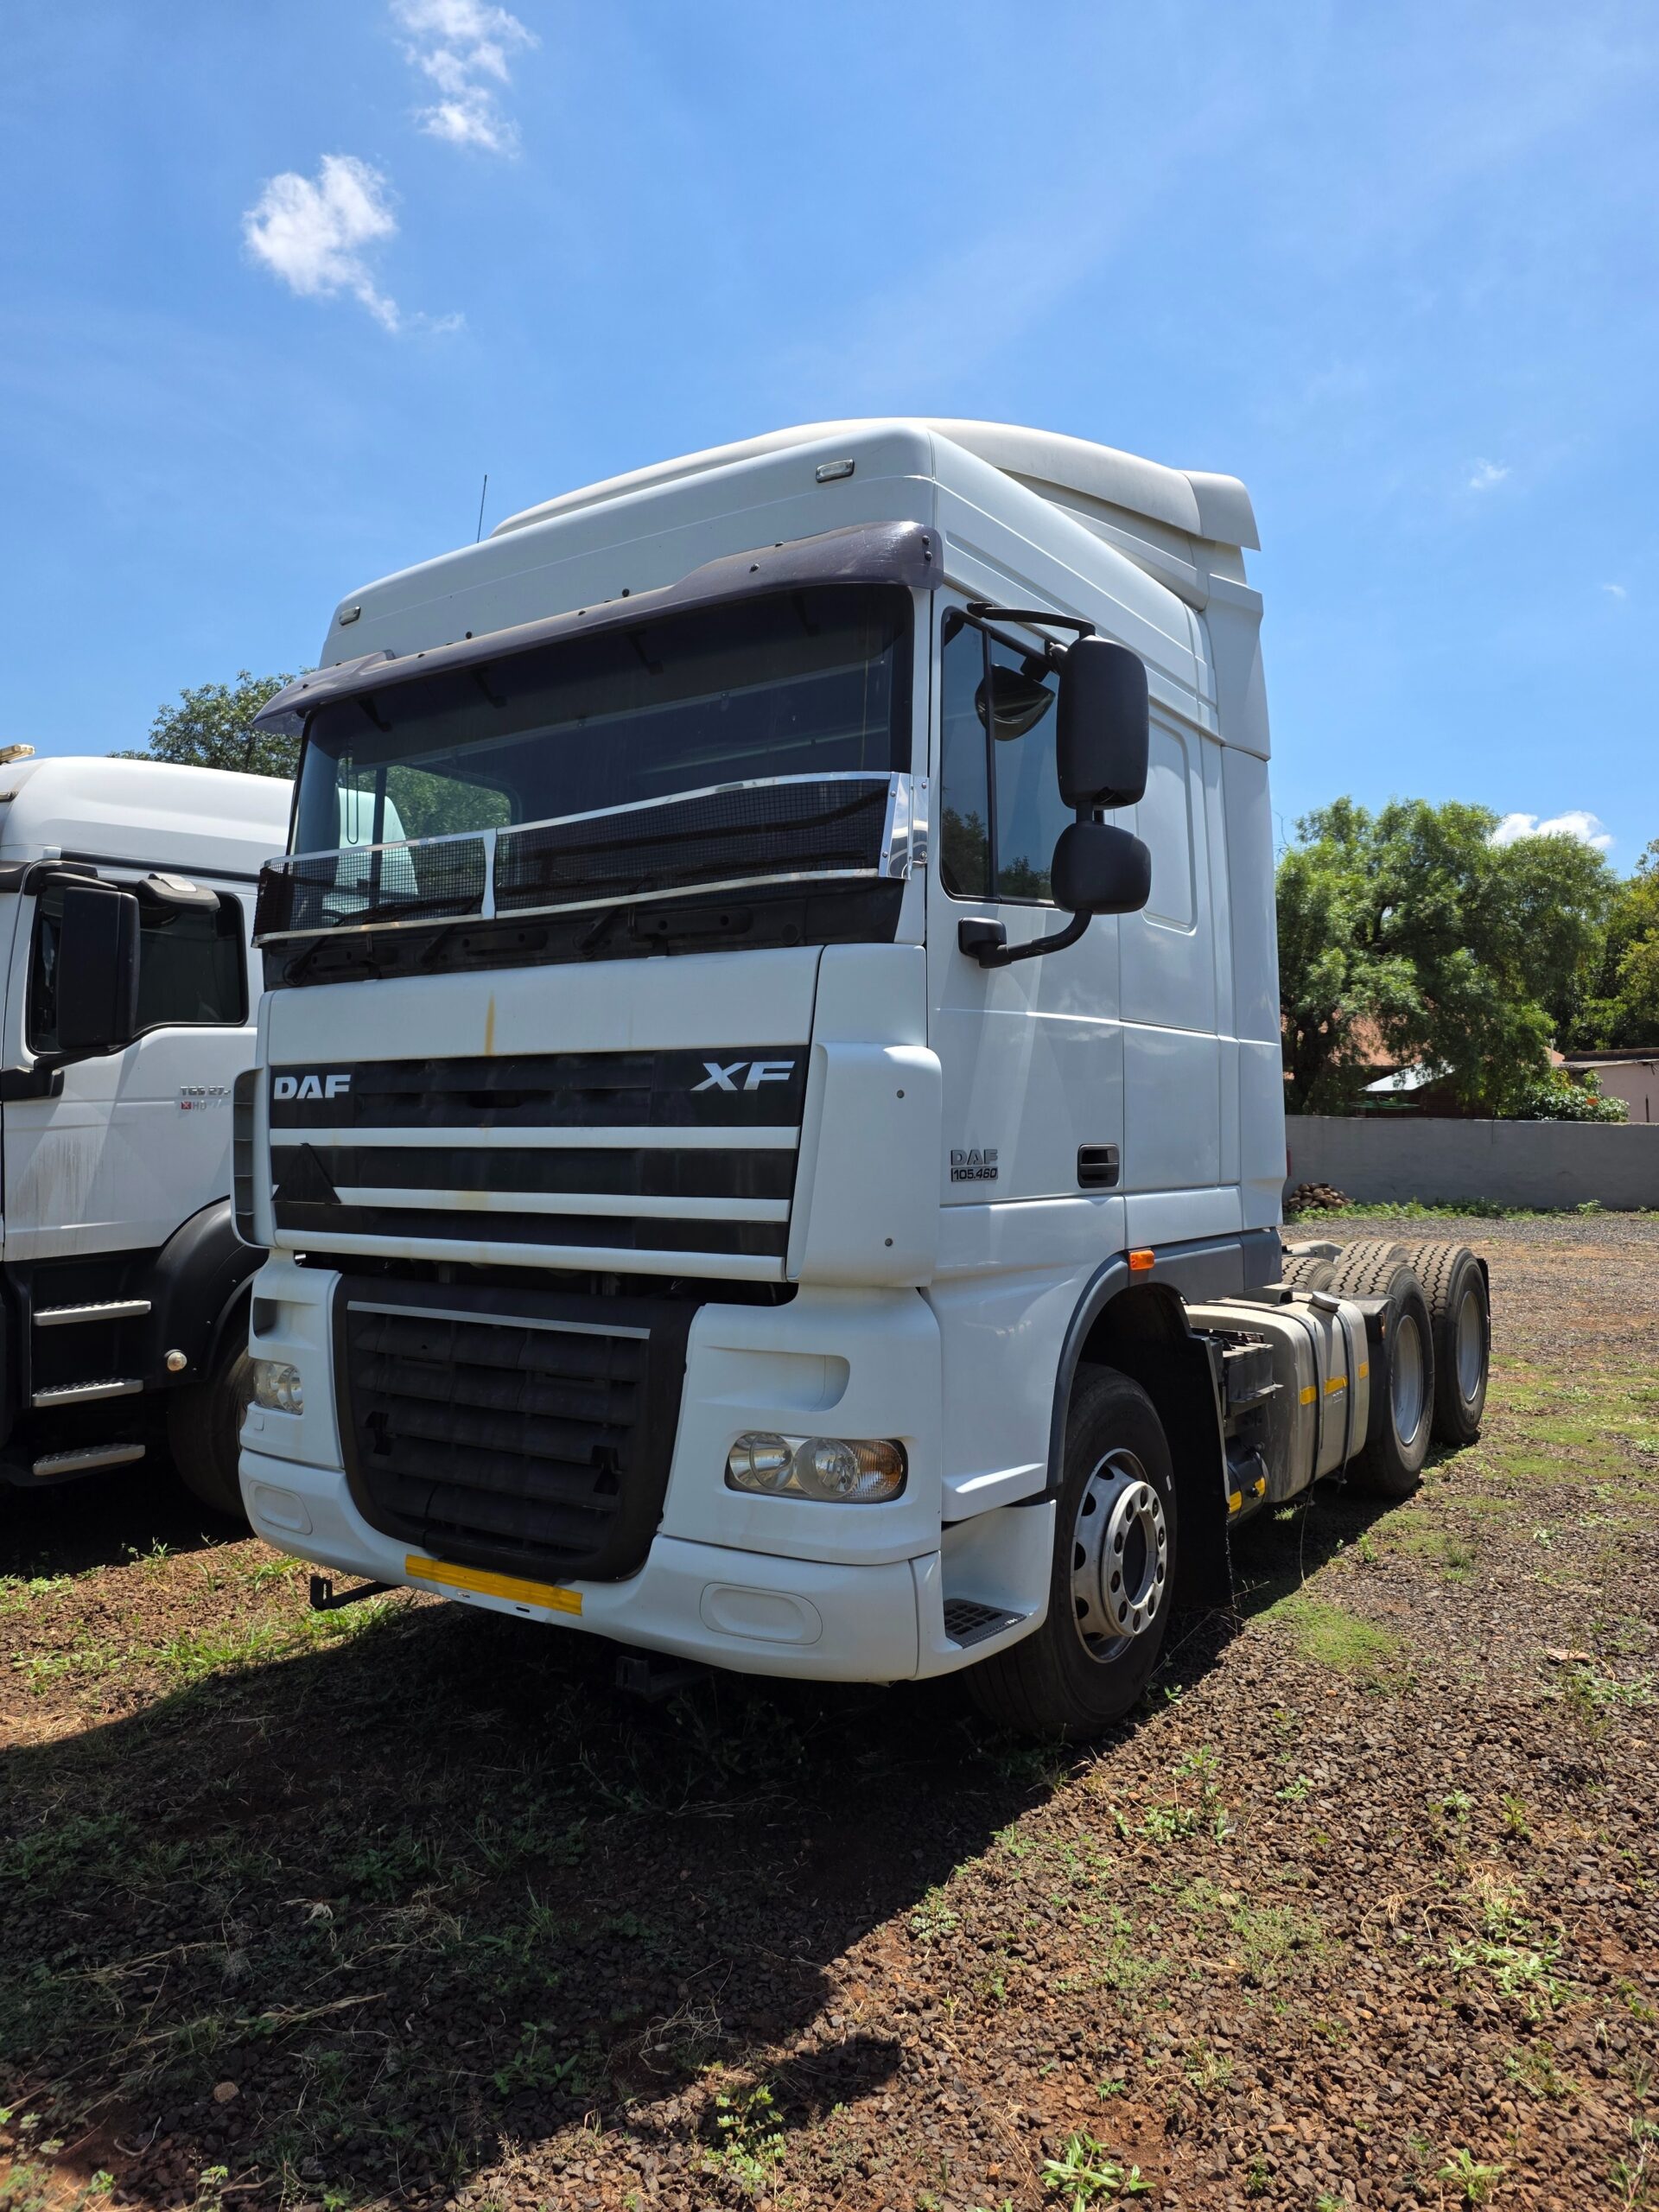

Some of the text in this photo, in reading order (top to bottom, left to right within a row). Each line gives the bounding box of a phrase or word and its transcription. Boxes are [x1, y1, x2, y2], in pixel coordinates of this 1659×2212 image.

[690, 1061, 795, 1090] XF
[180, 1085, 206, 1096] TGS
[273, 1074, 351, 1099] DAF
[950, 1148, 998, 1166] DAF
[953, 1167, 997, 1180] 105.460
